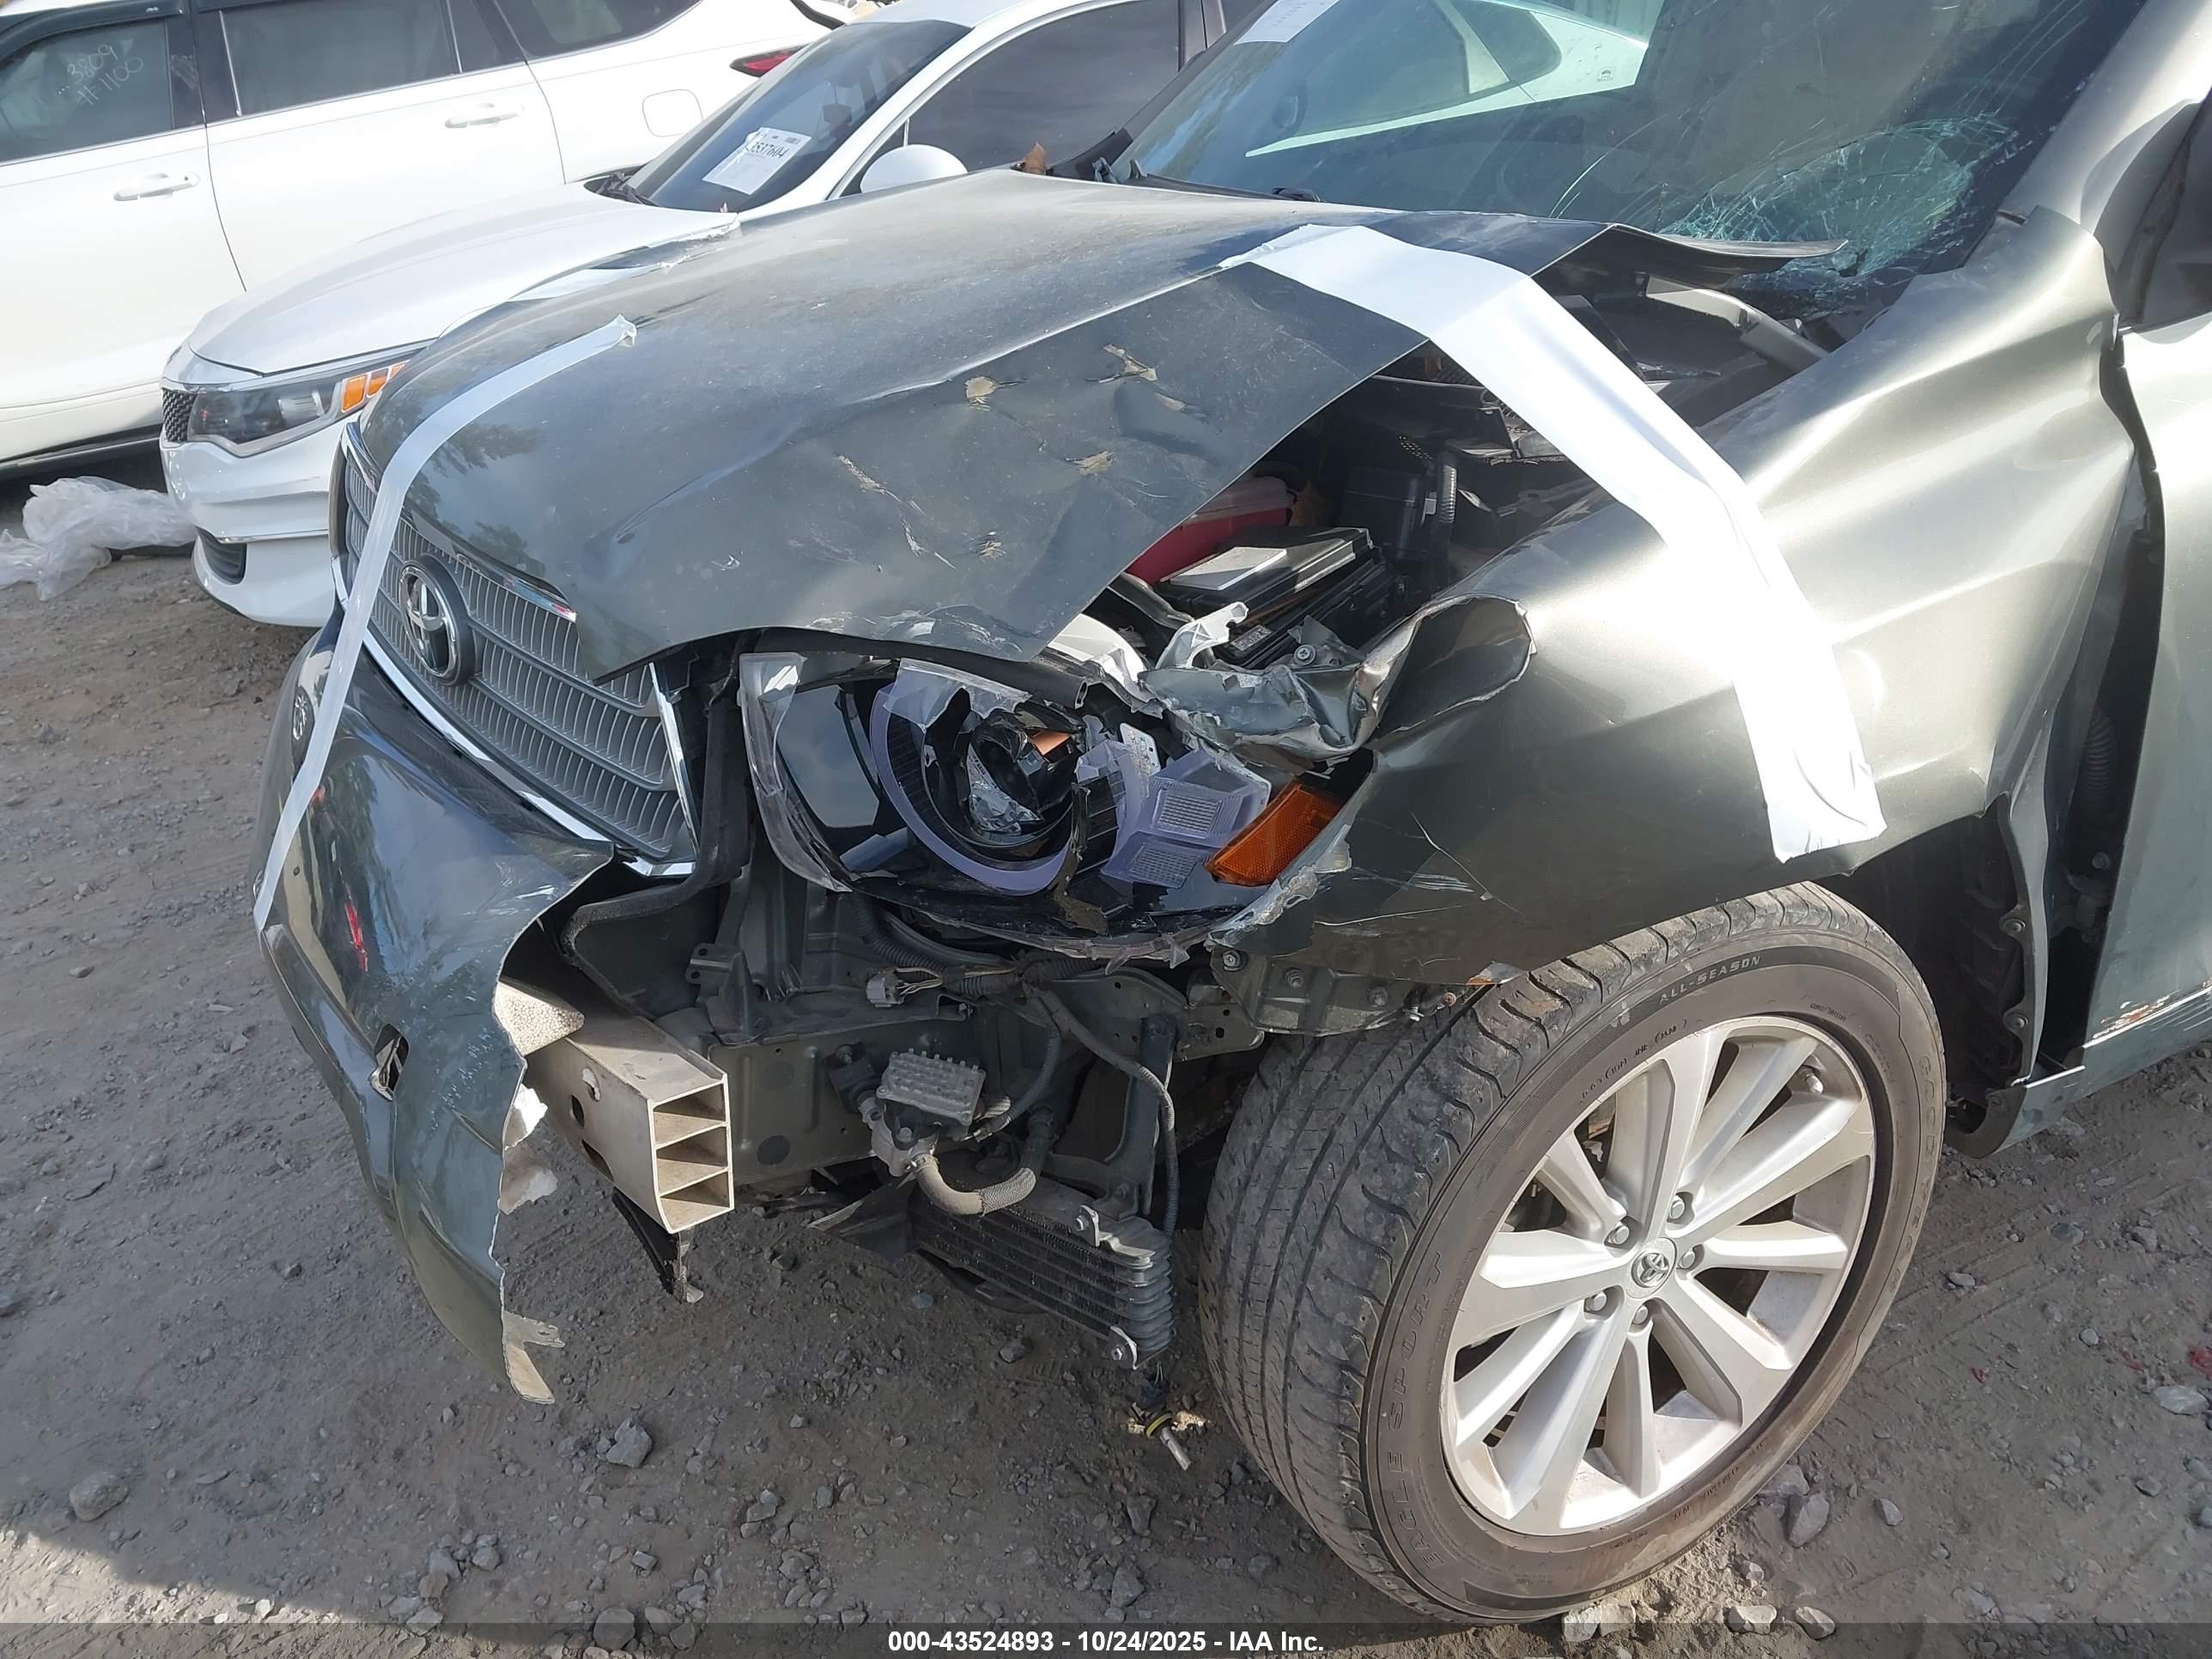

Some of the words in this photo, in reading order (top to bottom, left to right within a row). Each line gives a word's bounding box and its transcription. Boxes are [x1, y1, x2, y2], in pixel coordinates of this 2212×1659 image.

[67, 44, 118, 84] 3809
[1659, 955, 1761, 1005] ALL-SEASON
[1388, 1251, 1441, 1430] SPORT
[1387, 1450, 1445, 1569] EAGLE
